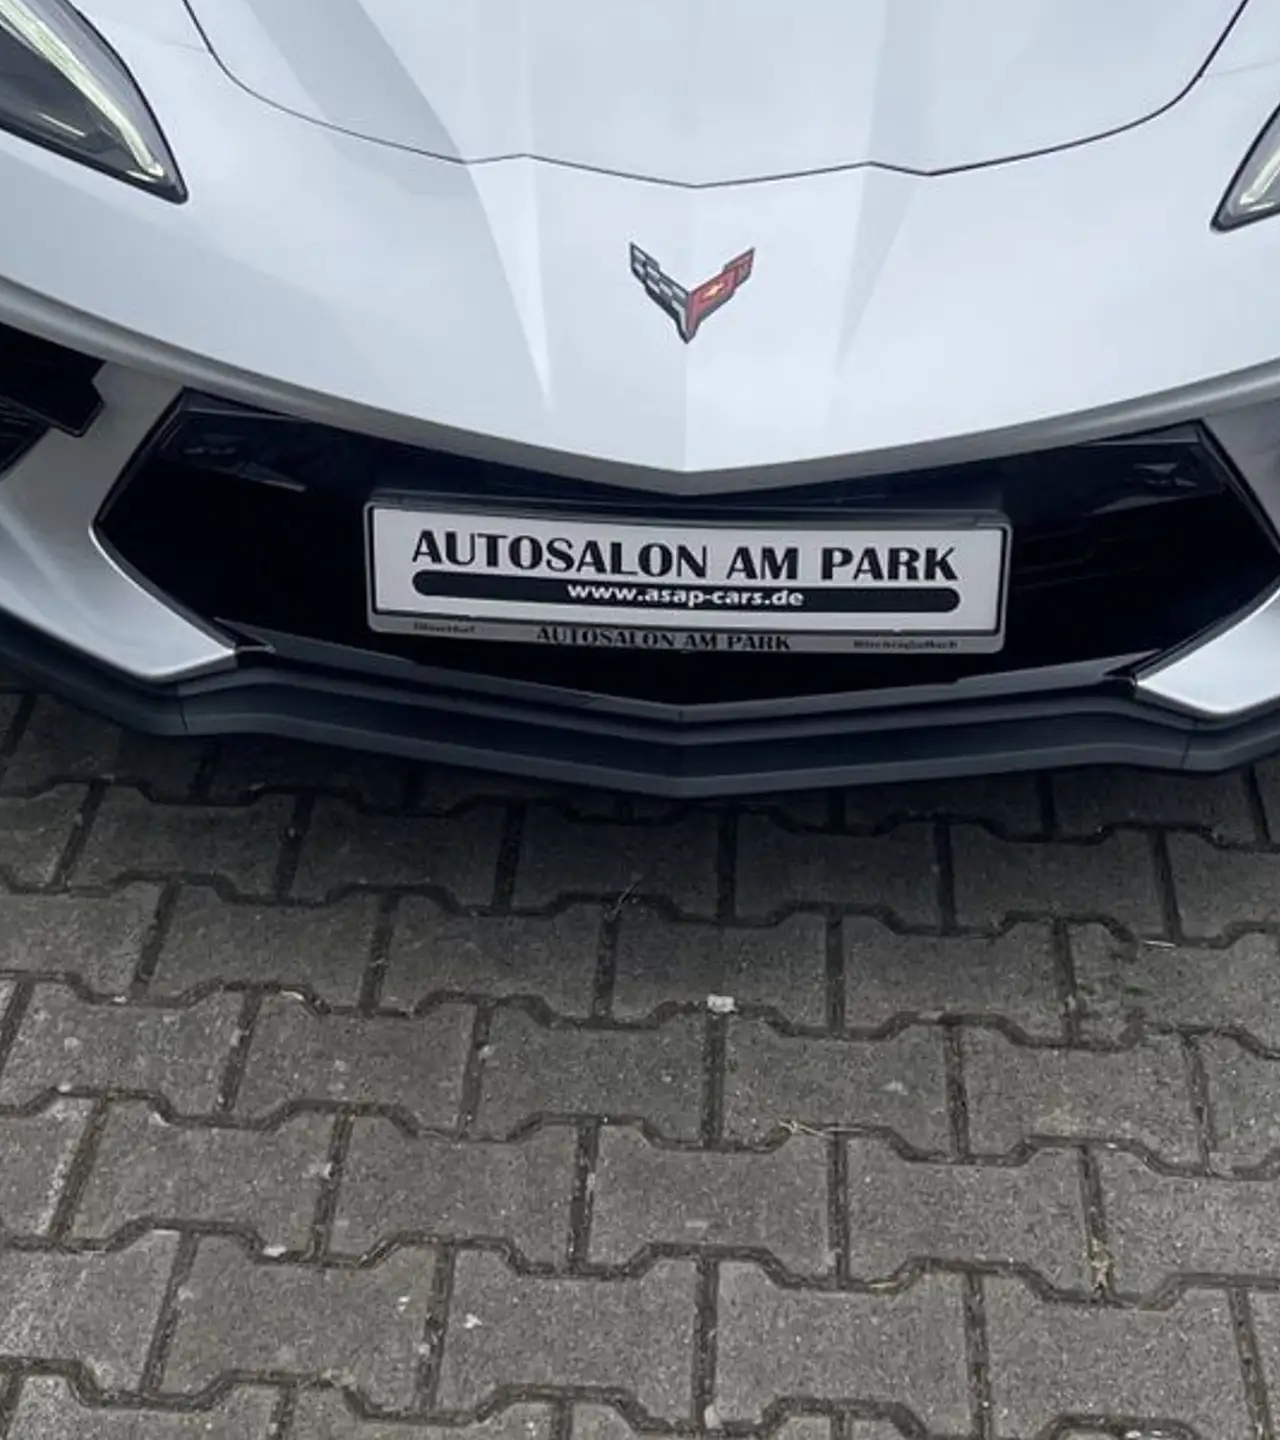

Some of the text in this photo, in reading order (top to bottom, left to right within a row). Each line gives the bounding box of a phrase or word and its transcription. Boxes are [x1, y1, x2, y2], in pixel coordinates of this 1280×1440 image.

[412, 529, 958, 581] AUTOSALON AM PARK
[567, 583, 804, 607] www.asap-cars.de
[536, 626, 791, 651] AUTOSALON AM PARK
